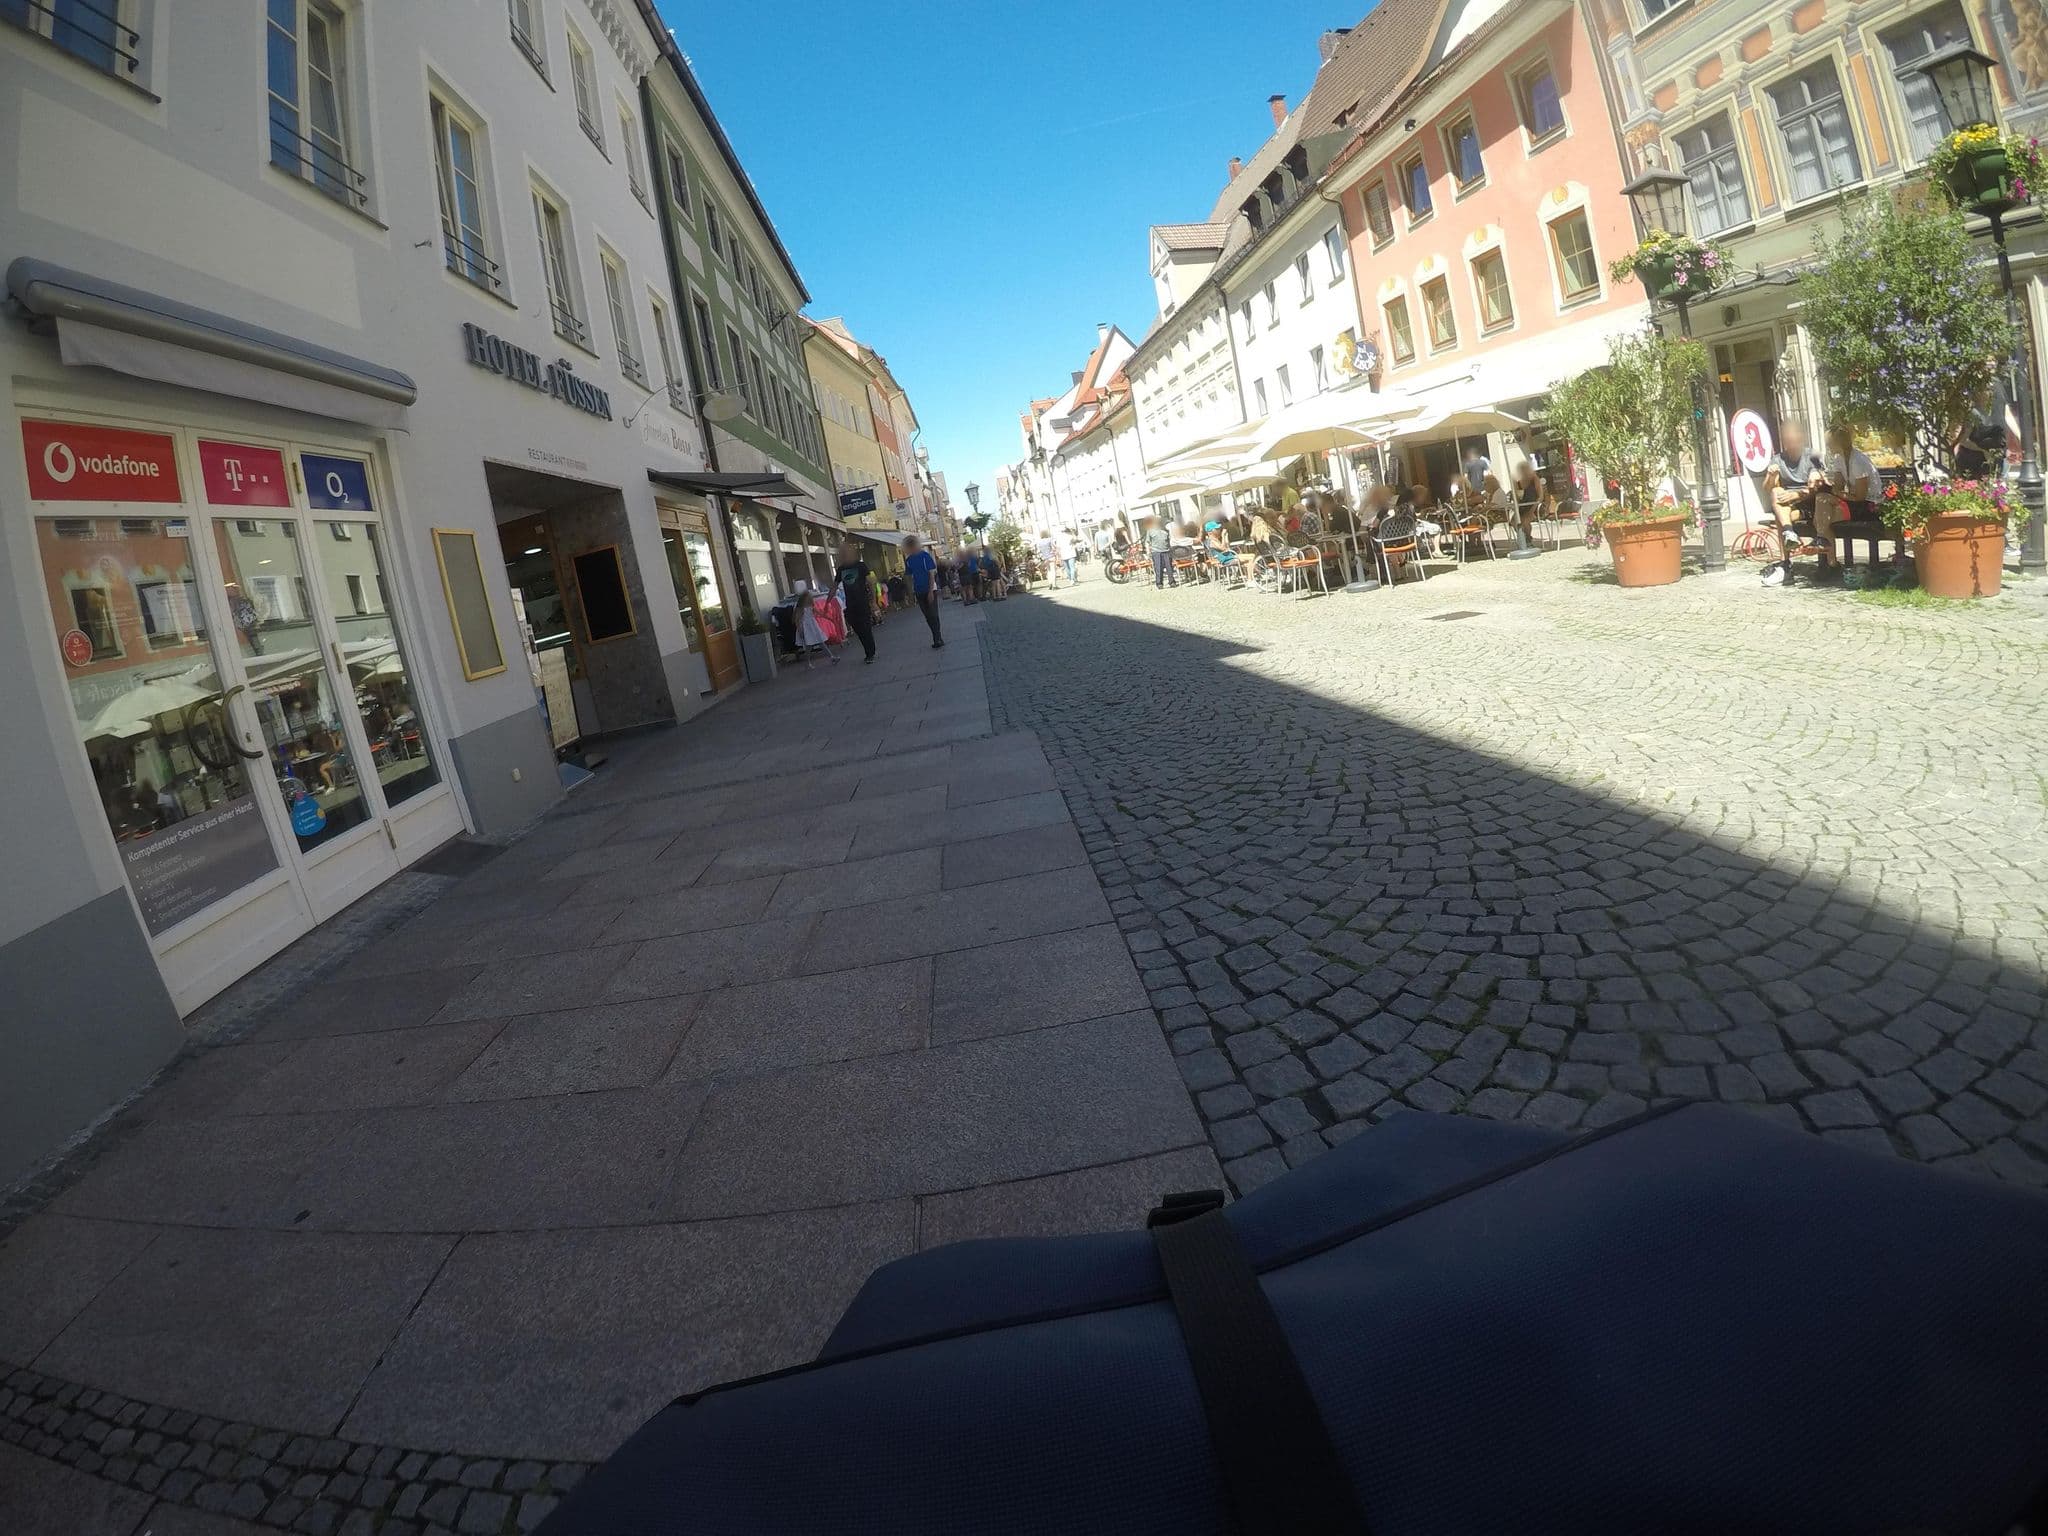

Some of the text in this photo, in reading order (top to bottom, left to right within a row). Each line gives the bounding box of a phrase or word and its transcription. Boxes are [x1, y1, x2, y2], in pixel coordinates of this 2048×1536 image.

[463, 322, 613, 421] HOTEL FÜSSEN
[80, 455, 160, 478] vodafone
[223, 458, 243, 492] T
[843, 499, 874, 511] engbers
[127, 834, 178, 862] Kompetenter
[177, 824, 205, 842] Service
[204, 817, 218, 829] aus
[217, 810, 235, 823] einer
[234, 801, 254, 816] Hand:
